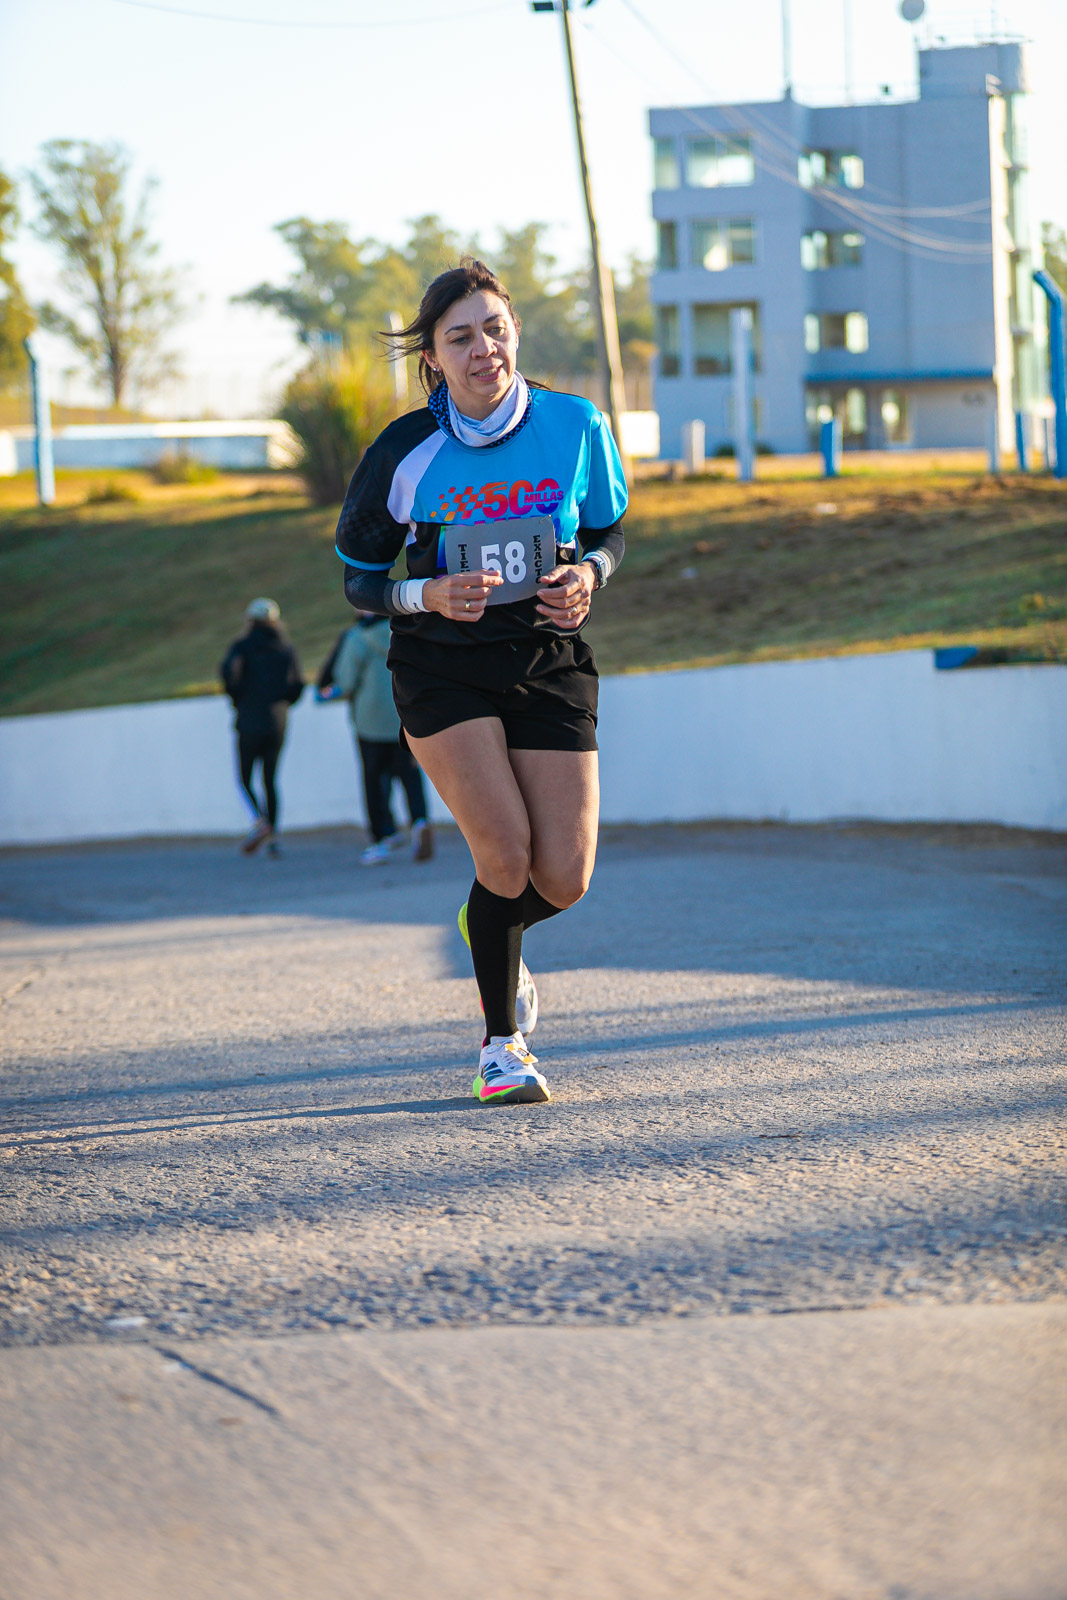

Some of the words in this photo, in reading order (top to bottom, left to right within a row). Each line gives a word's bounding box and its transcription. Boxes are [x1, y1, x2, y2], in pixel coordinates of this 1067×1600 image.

[482, 478, 560, 518] 500
[524, 490, 563, 503] MILLAS
[458, 544, 470, 572] TIE
[481, 541, 527, 583] 58
